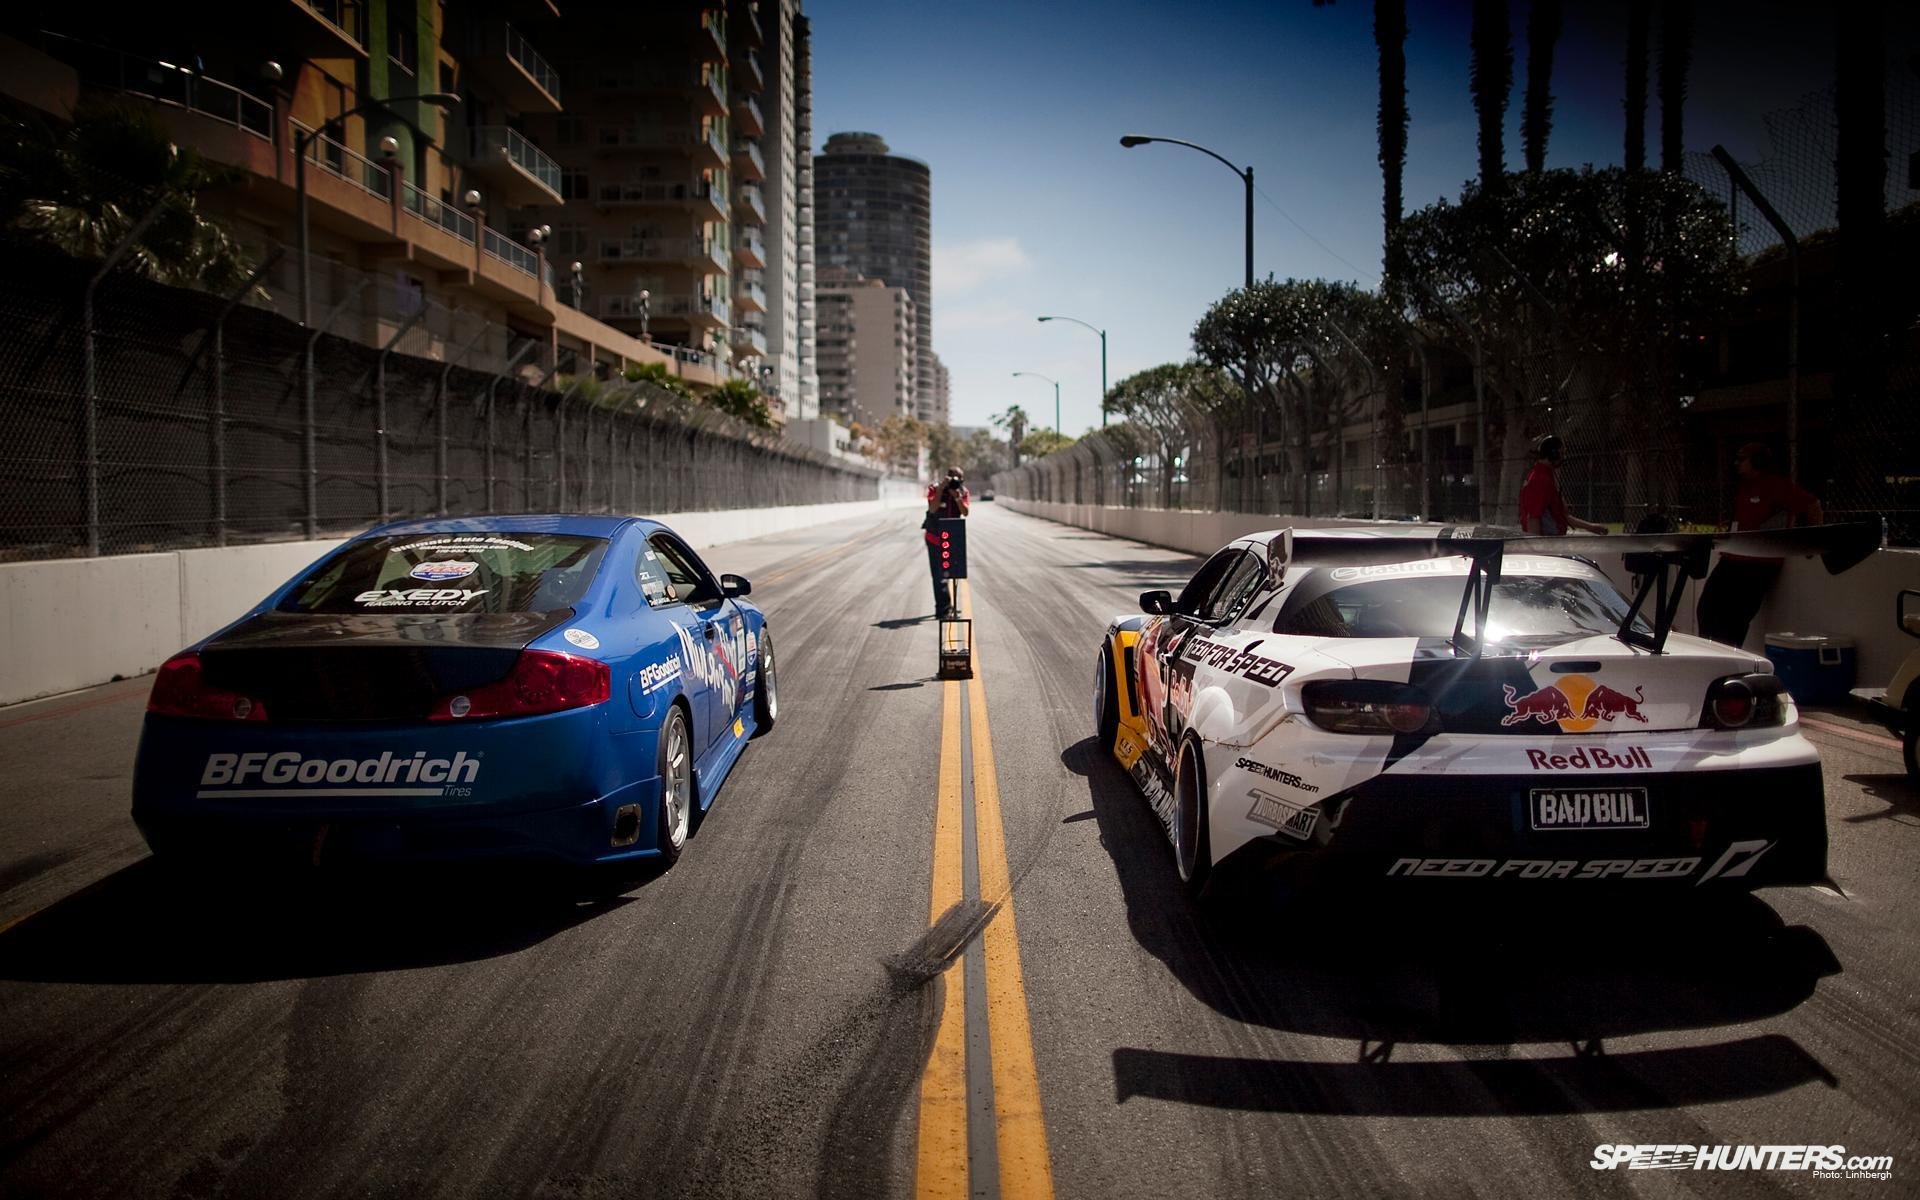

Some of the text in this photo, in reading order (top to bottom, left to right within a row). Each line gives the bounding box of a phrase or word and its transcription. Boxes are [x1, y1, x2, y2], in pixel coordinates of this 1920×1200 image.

[1359, 561, 1440, 577] Castrol
[354, 588, 490, 602] EXEDY
[640, 652, 682, 689] BFGoodrich
[1180, 637, 1296, 689] NEED FOR SPEED
[200, 751, 480, 784] BFGoodrich
[1525, 746, 1653, 770] Red Bull
[444, 784, 472, 797] Tires
[1540, 792, 1645, 825] BAD BUL
[1386, 856, 1702, 879] NEED FOR SPEED
